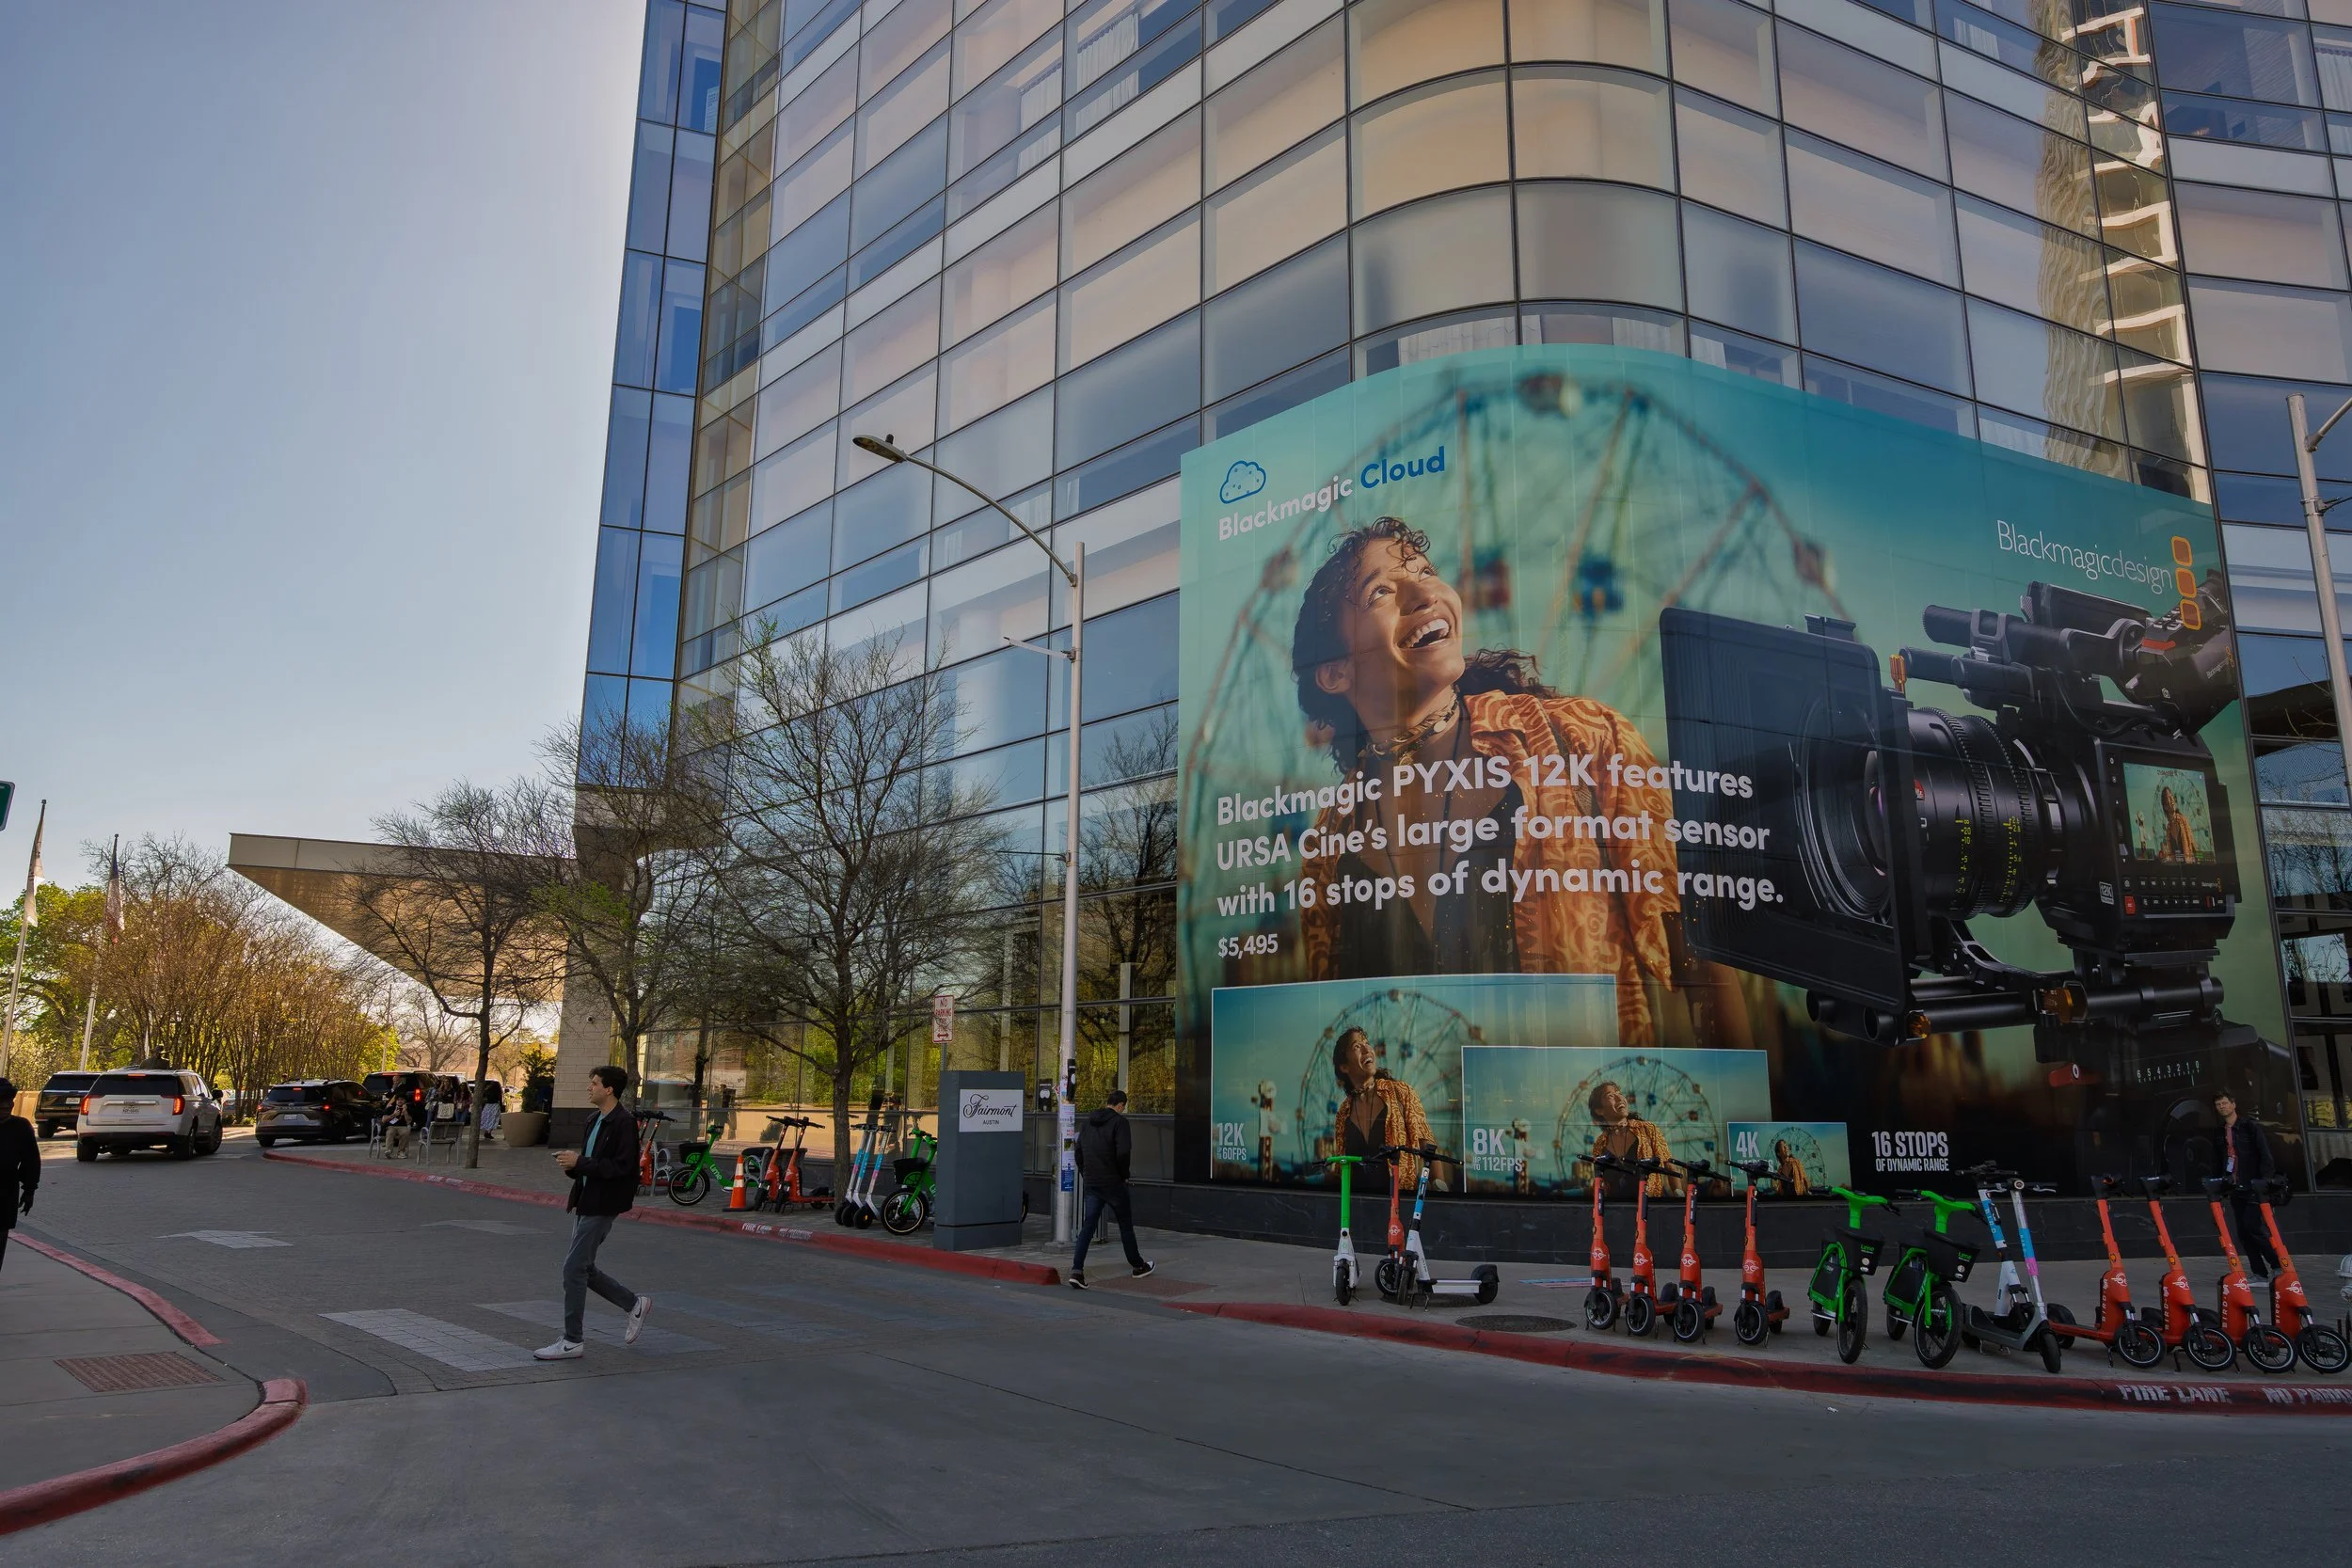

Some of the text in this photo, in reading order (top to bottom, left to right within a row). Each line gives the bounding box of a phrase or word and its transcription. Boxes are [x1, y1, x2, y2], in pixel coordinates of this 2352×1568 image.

[1219, 446, 1445, 541] Blackmagic Cloud
[1997, 519, 2172, 594] Blackmagicdesign
[1217, 753, 1753, 825] Blackmagic PYXIS 12K features
[1217, 805, 1770, 870] URSA Cine's large format sensor
[1217, 858, 1783, 917] with 16 stops of dynamic range.
[2100, 884, 2112, 897] 12K
[1217, 932, 1279, 959] $5,495
[963, 1093, 1018, 1118] Fairmont
[1216, 1122, 1245, 1147] 12K
[1472, 1128, 1505, 1156] 8K
[1736, 1131, 1760, 1158] 4K
[1871, 1131, 1949, 1158] 16 STOPS
[1222, 1147, 1247, 1161] 60FPS
[1472, 1163, 1481, 1171] TO
[1482, 1156, 1523, 1172] 112FPS
[1875, 1158, 1949, 1172] OF DYNAMIC RANGE
[2116, 1385, 2233, 1404] FIRE LANE
[2261, 1387, 2294, 1404] NO
